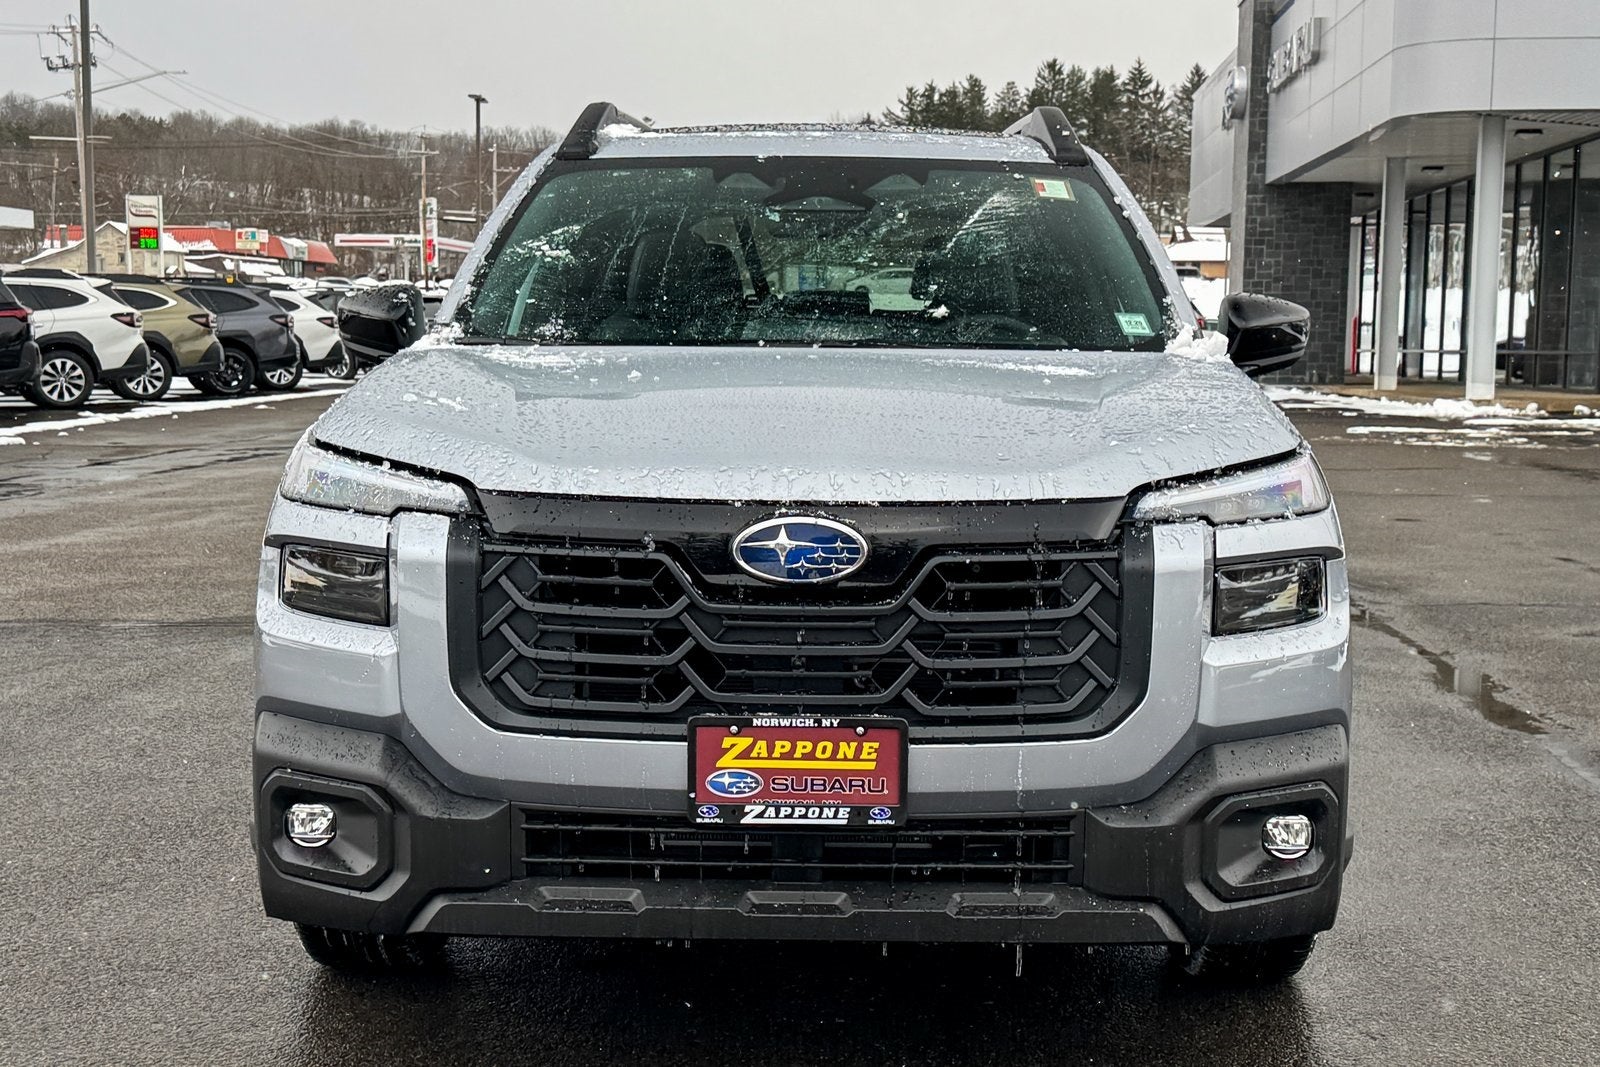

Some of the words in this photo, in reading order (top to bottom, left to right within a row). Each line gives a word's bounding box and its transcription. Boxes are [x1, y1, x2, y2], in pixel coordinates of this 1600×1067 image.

[822, 718, 840, 728] NY
[715, 736, 880, 770] ZAPPONE
[770, 776, 886, 794] SUBARU
[740, 804, 851, 824] ZAPPONE
